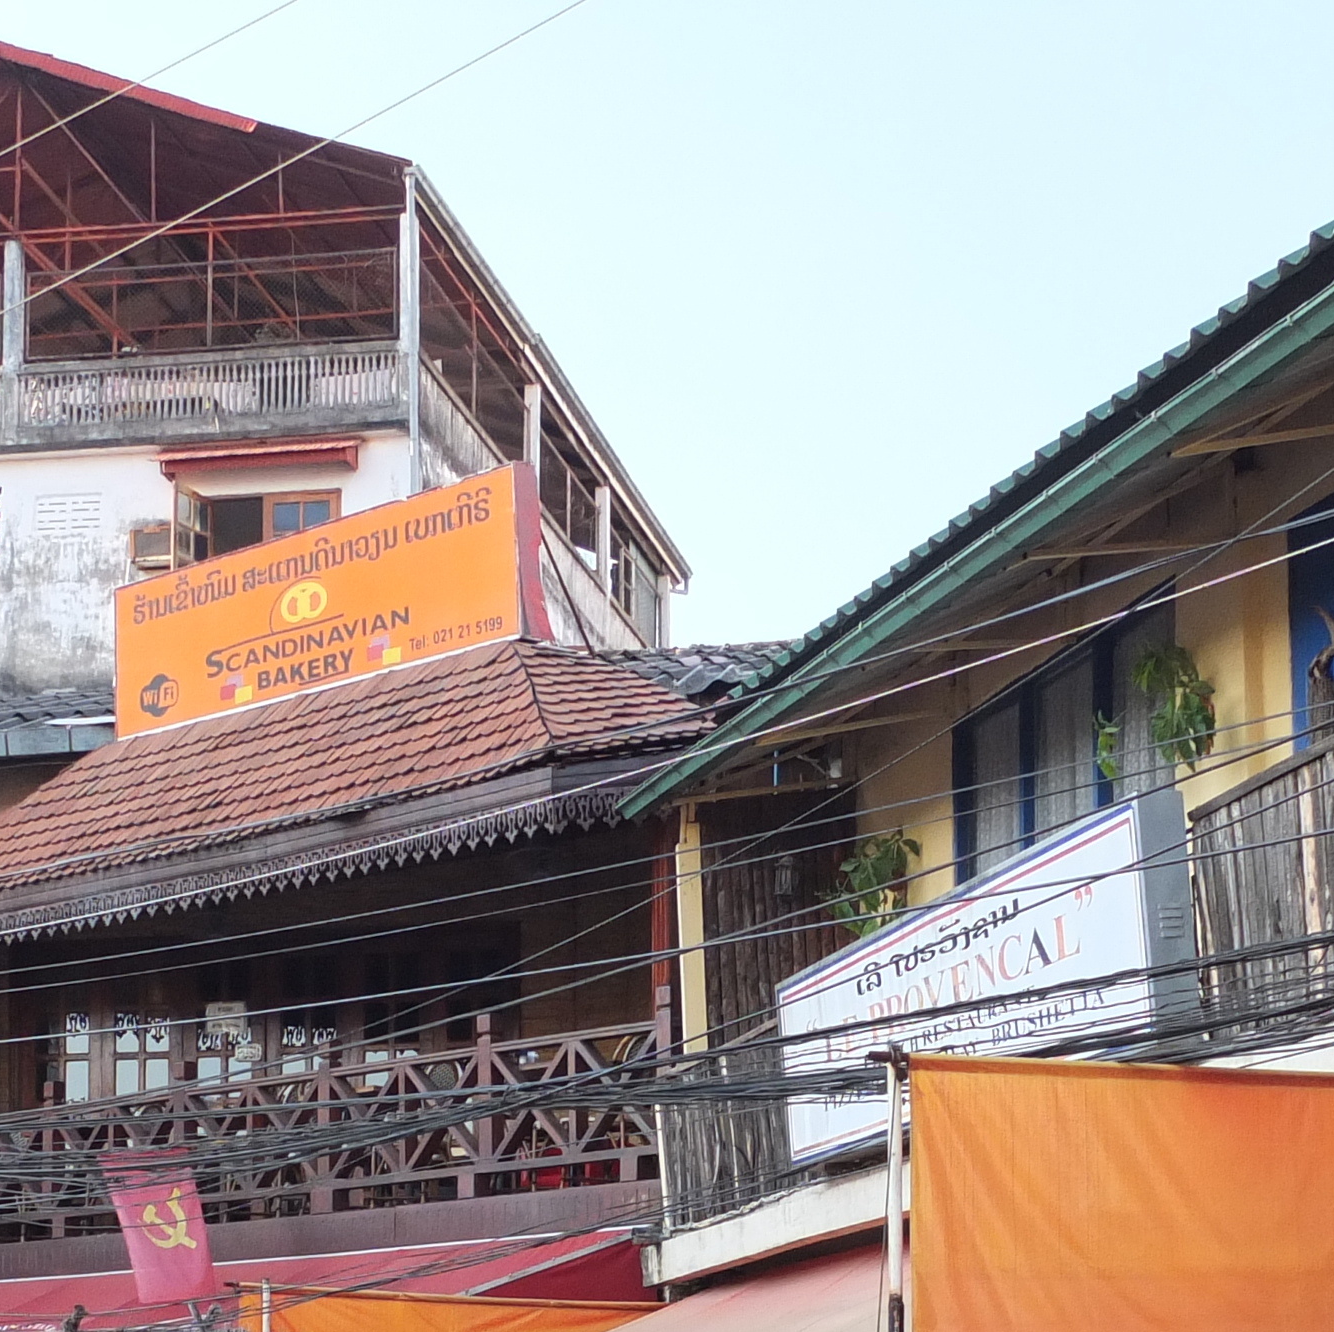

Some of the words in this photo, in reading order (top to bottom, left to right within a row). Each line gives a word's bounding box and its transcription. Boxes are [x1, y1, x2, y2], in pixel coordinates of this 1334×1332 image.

[205, 607, 410, 678] SCANDINAVIAN
[409, 636, 430, 652] Tel:
[433, 628, 454, 645] 021
[457, 623, 472, 641] 21
[475, 616, 503, 637] 5199
[257, 648, 354, 691] BAKERY
